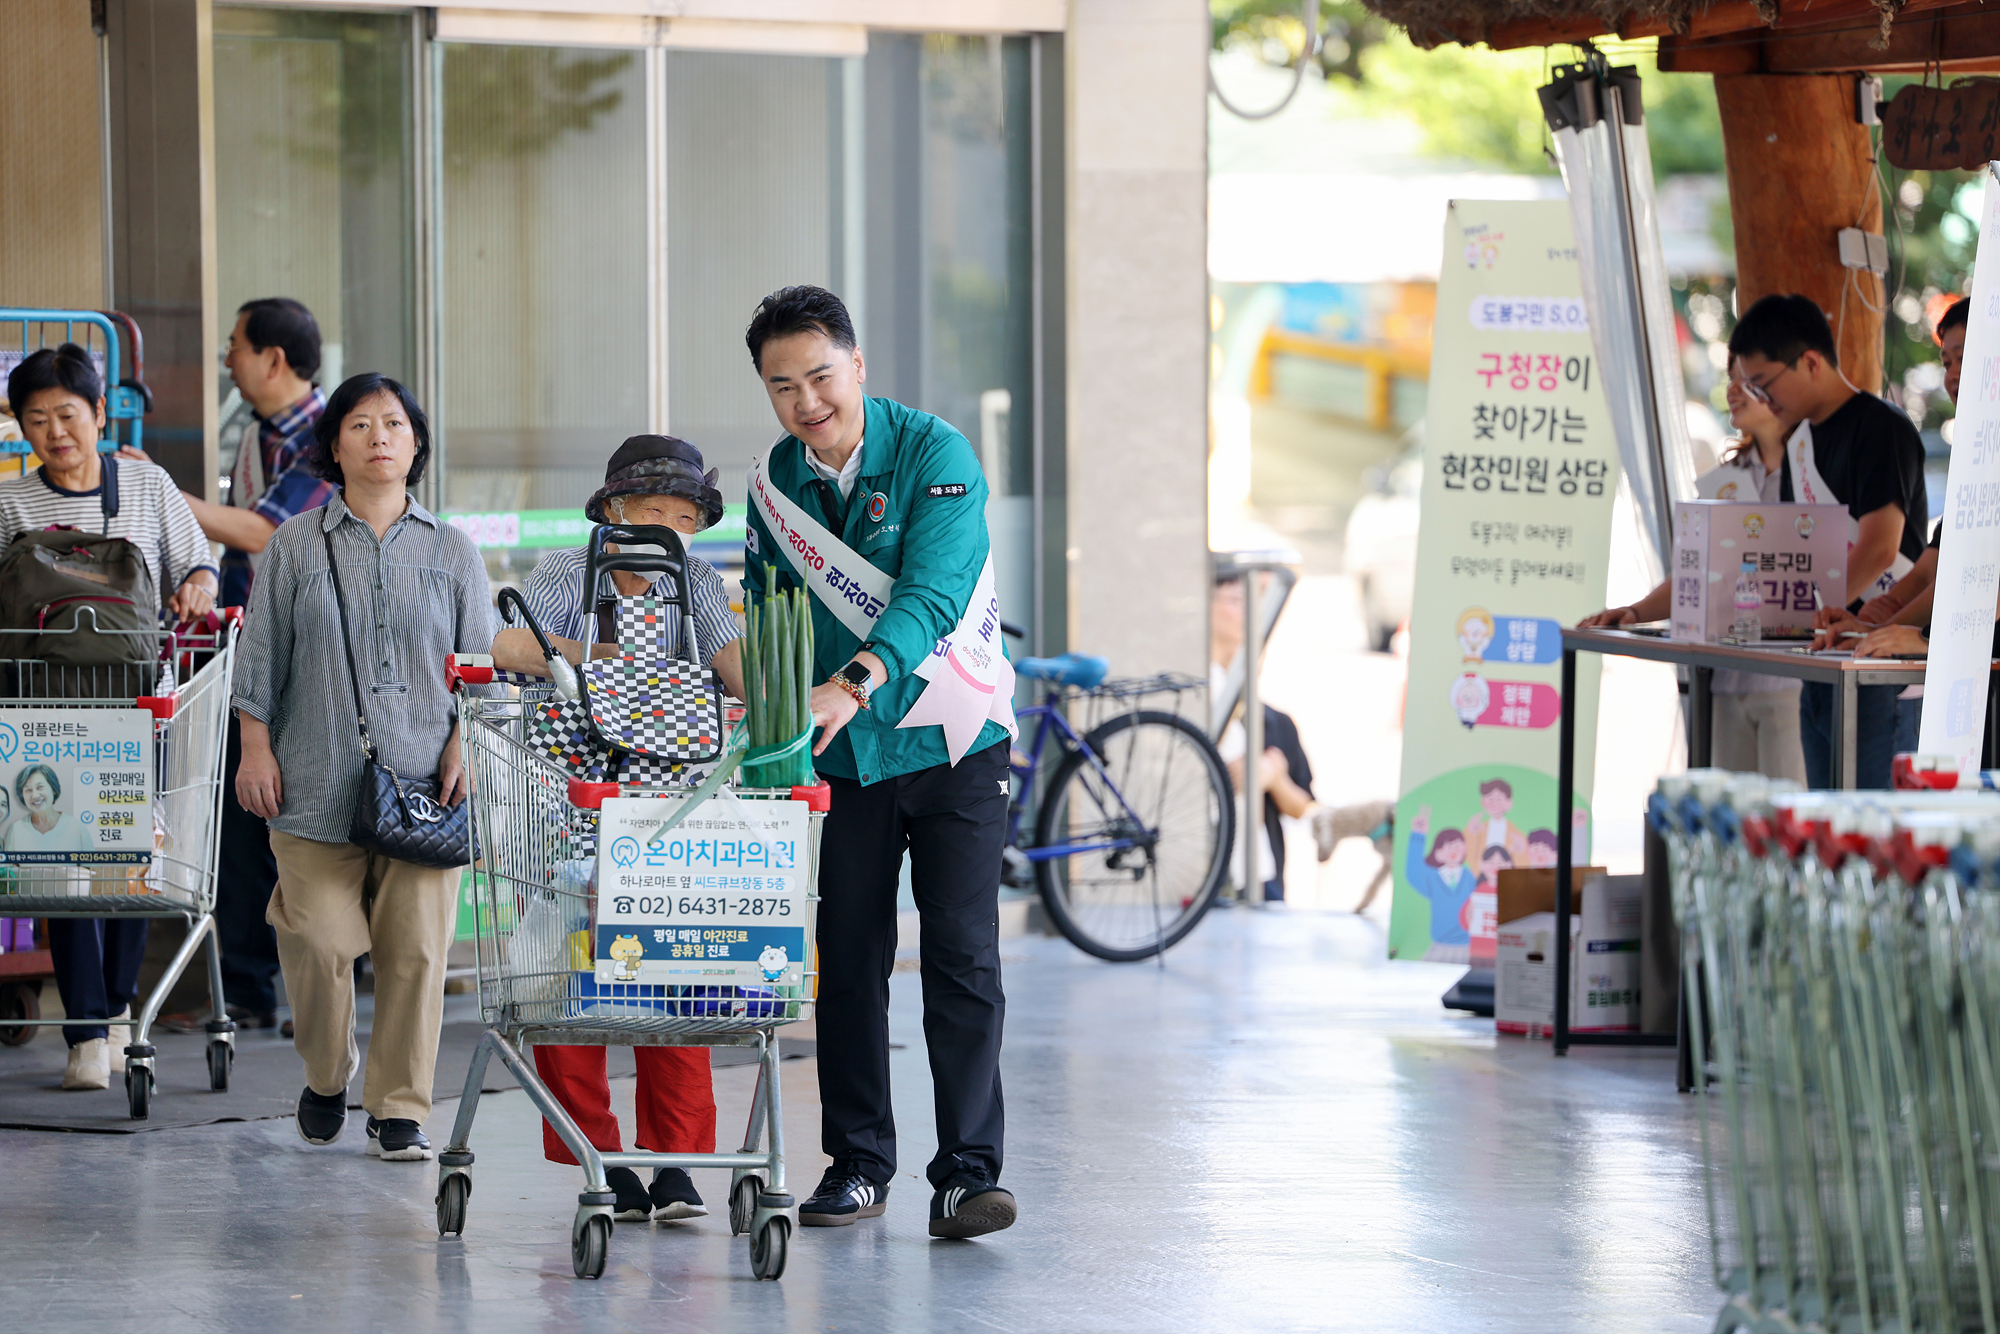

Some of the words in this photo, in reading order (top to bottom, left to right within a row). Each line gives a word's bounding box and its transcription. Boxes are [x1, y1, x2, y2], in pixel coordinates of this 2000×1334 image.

[1476, 353, 1591, 391] 구청장이
[1472, 403, 1587, 443] 찾아가는
[1441, 453, 1548, 494] 현장민원
[1556, 457, 1608, 497] 상담
[930, 486, 943, 495] 서울
[944, 485, 965, 495] 도봉구
[22, 722, 89, 737] 임플란트는
[21, 740, 141, 763] 온아치과의원
[99, 772, 145, 786] 평일매일
[98, 790, 145, 803] 야간진료
[98, 811, 134, 825] 공휴일
[687, 820, 703, 829] 위한
[764, 821, 779, 830] 노력
[99, 829, 122, 842] 진료
[643, 838, 795, 869] 온아치과의원
[620, 875, 677, 888] 하나로마트
[680, 876, 691, 889] 옆
[694, 876, 764, 890] 씨드큐브창동
[766, 877, 786, 891] 5층
[639, 896, 673, 917] 02)
[678, 897, 791, 916] 6431-2875
[653, 929, 676, 943] 평일
[678, 930, 701, 943] 매일
[703, 930, 749, 943] 야간진료
[671, 944, 705, 957] 공휴일
[707, 944, 730, 957] 진료
